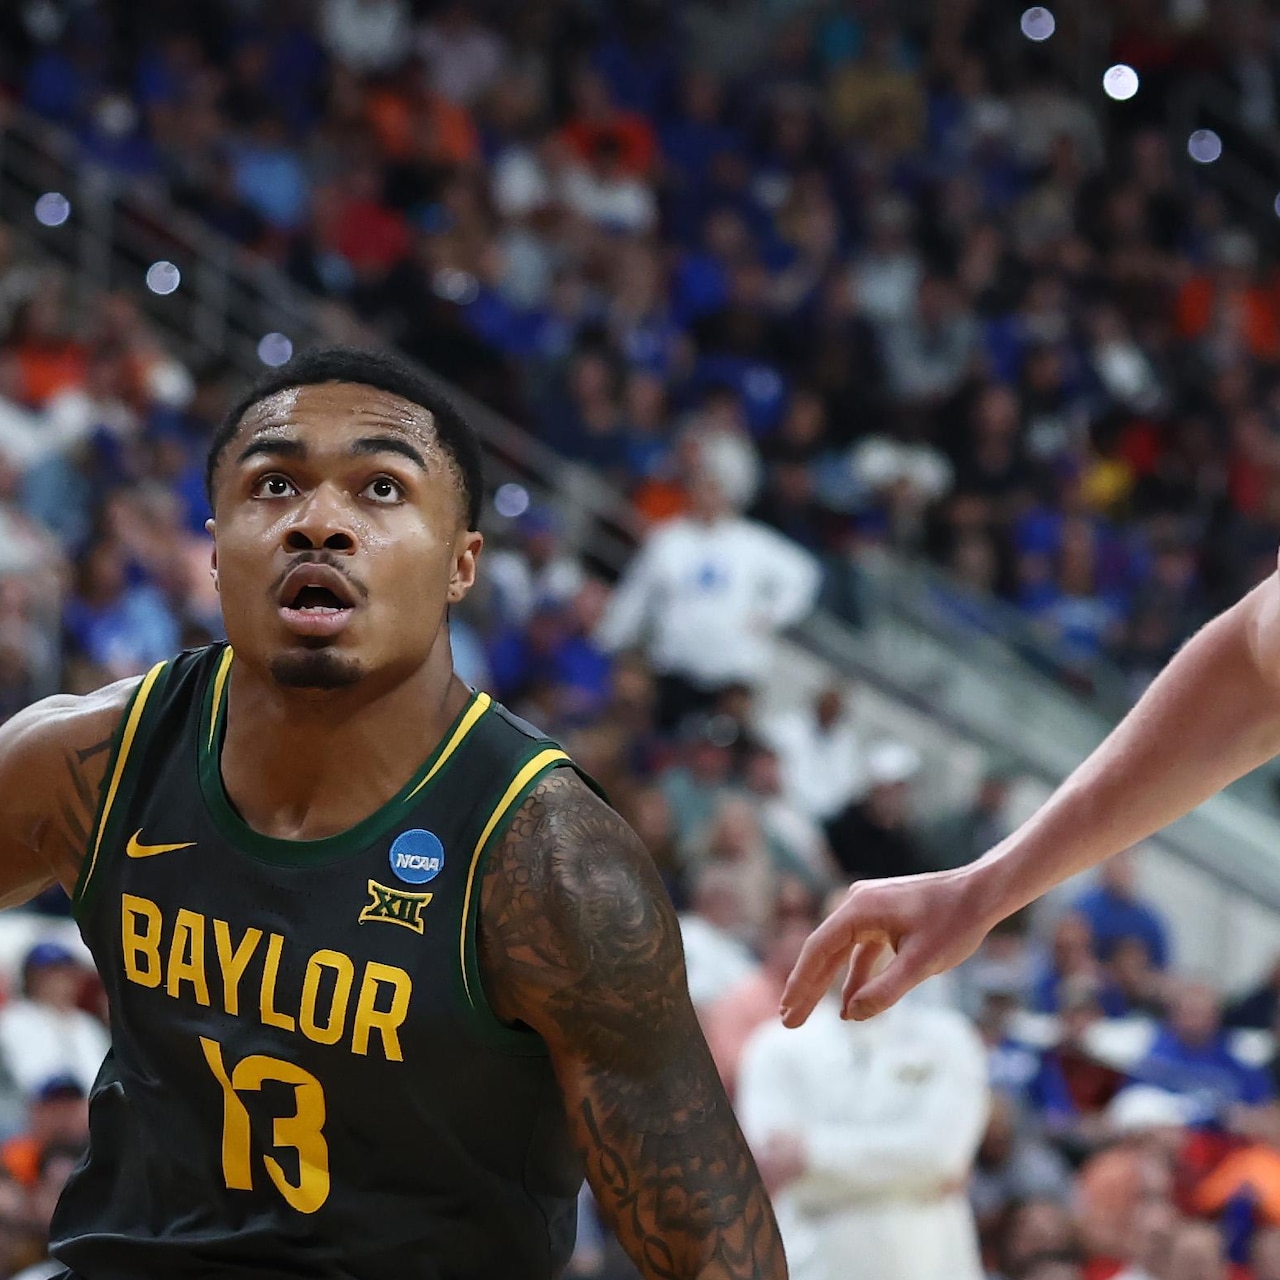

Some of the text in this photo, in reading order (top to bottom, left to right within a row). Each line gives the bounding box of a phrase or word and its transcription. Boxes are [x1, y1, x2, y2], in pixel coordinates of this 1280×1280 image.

[395, 852, 441, 872] NCAA
[121, 892, 412, 1062] BAYLOR
[199, 1035, 331, 1215] 13
